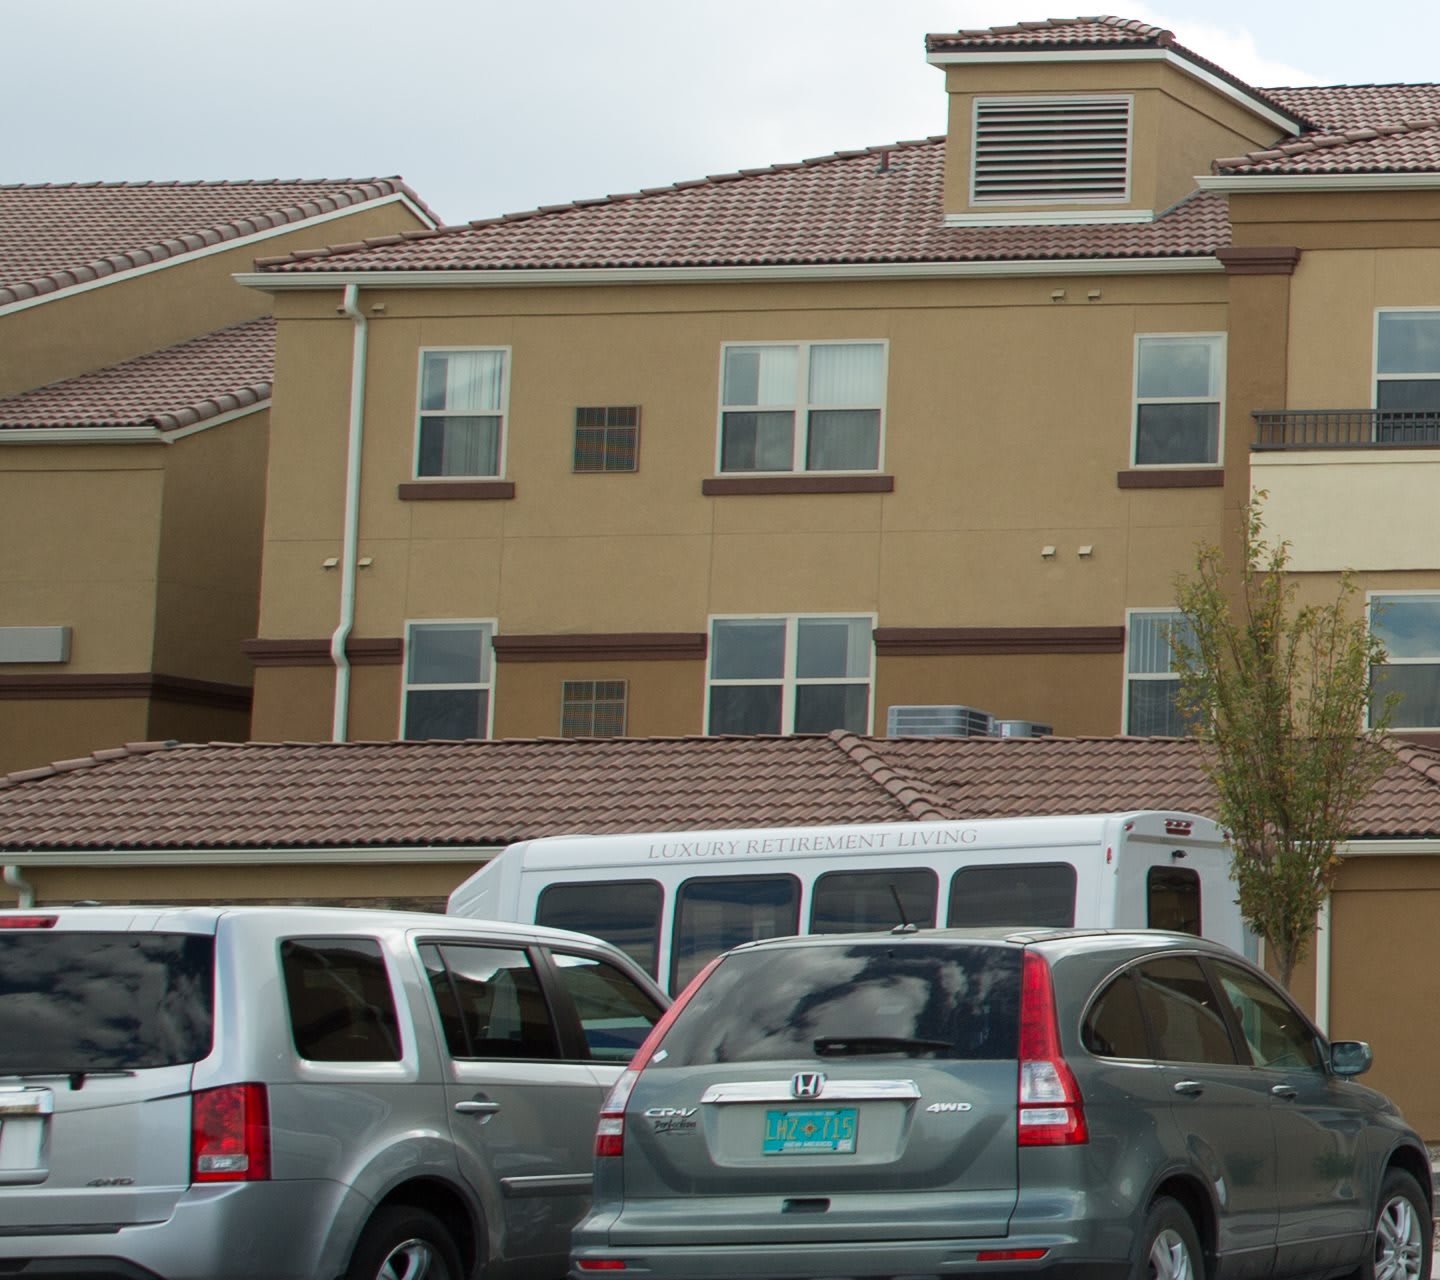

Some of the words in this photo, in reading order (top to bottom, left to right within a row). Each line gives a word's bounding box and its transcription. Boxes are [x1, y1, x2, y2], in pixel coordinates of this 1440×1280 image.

[648, 839, 741, 860] LUXURY
[745, 832, 892, 855] RETIREMENT
[897, 829, 978, 848] LIVING
[644, 1107, 700, 1118] CR-V
[925, 1102, 973, 1114] 4WD
[766, 1118, 800, 1141] LHZ
[822, 1115, 856, 1141] 715
